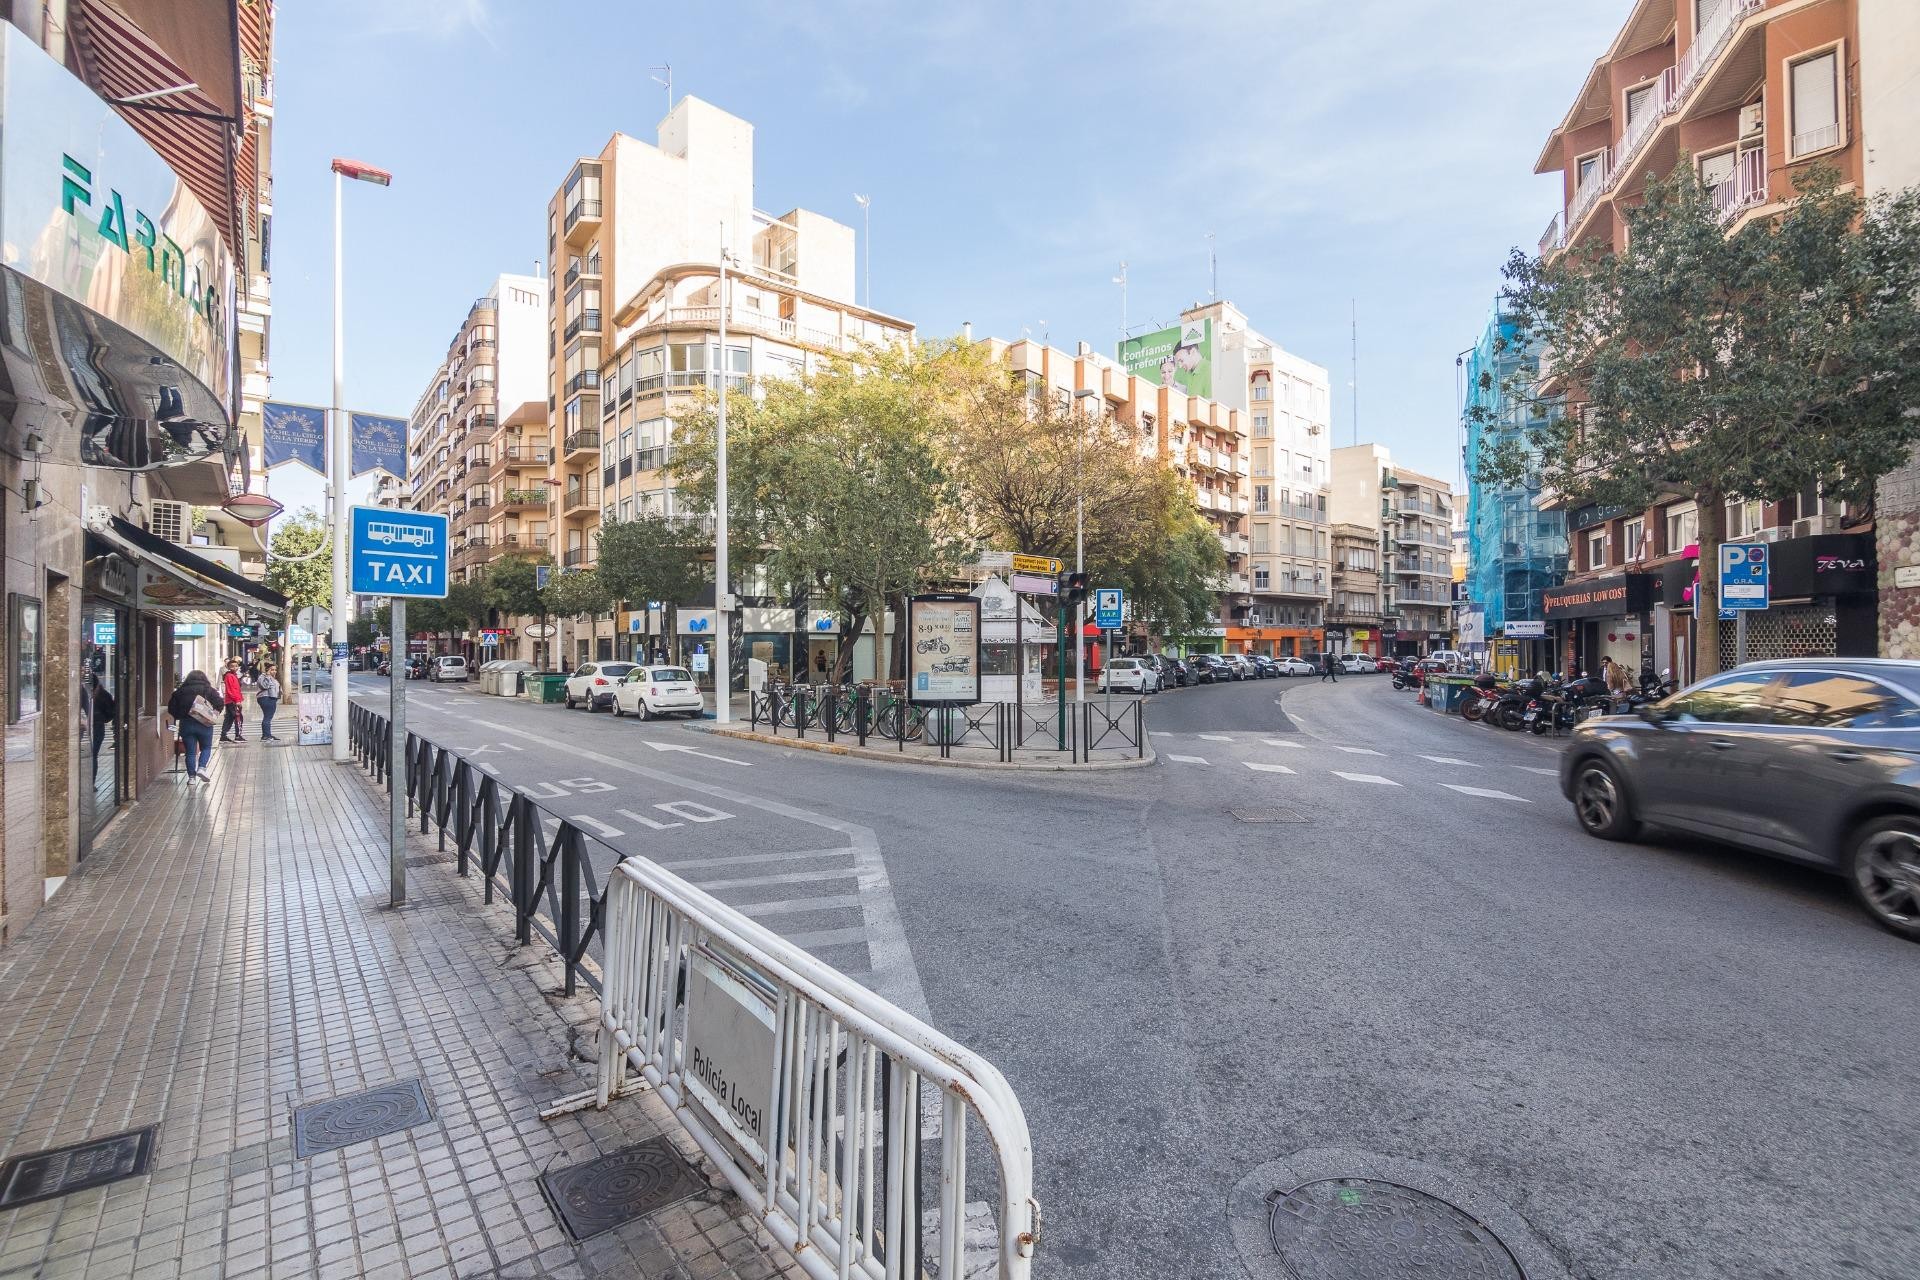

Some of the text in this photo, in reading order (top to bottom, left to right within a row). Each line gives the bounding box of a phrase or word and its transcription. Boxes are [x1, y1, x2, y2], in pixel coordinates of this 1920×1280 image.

[368, 562, 432, 584] TAXI
[1723, 547, 1746, 573] P
[694, 1046, 762, 1137] Policía Local
